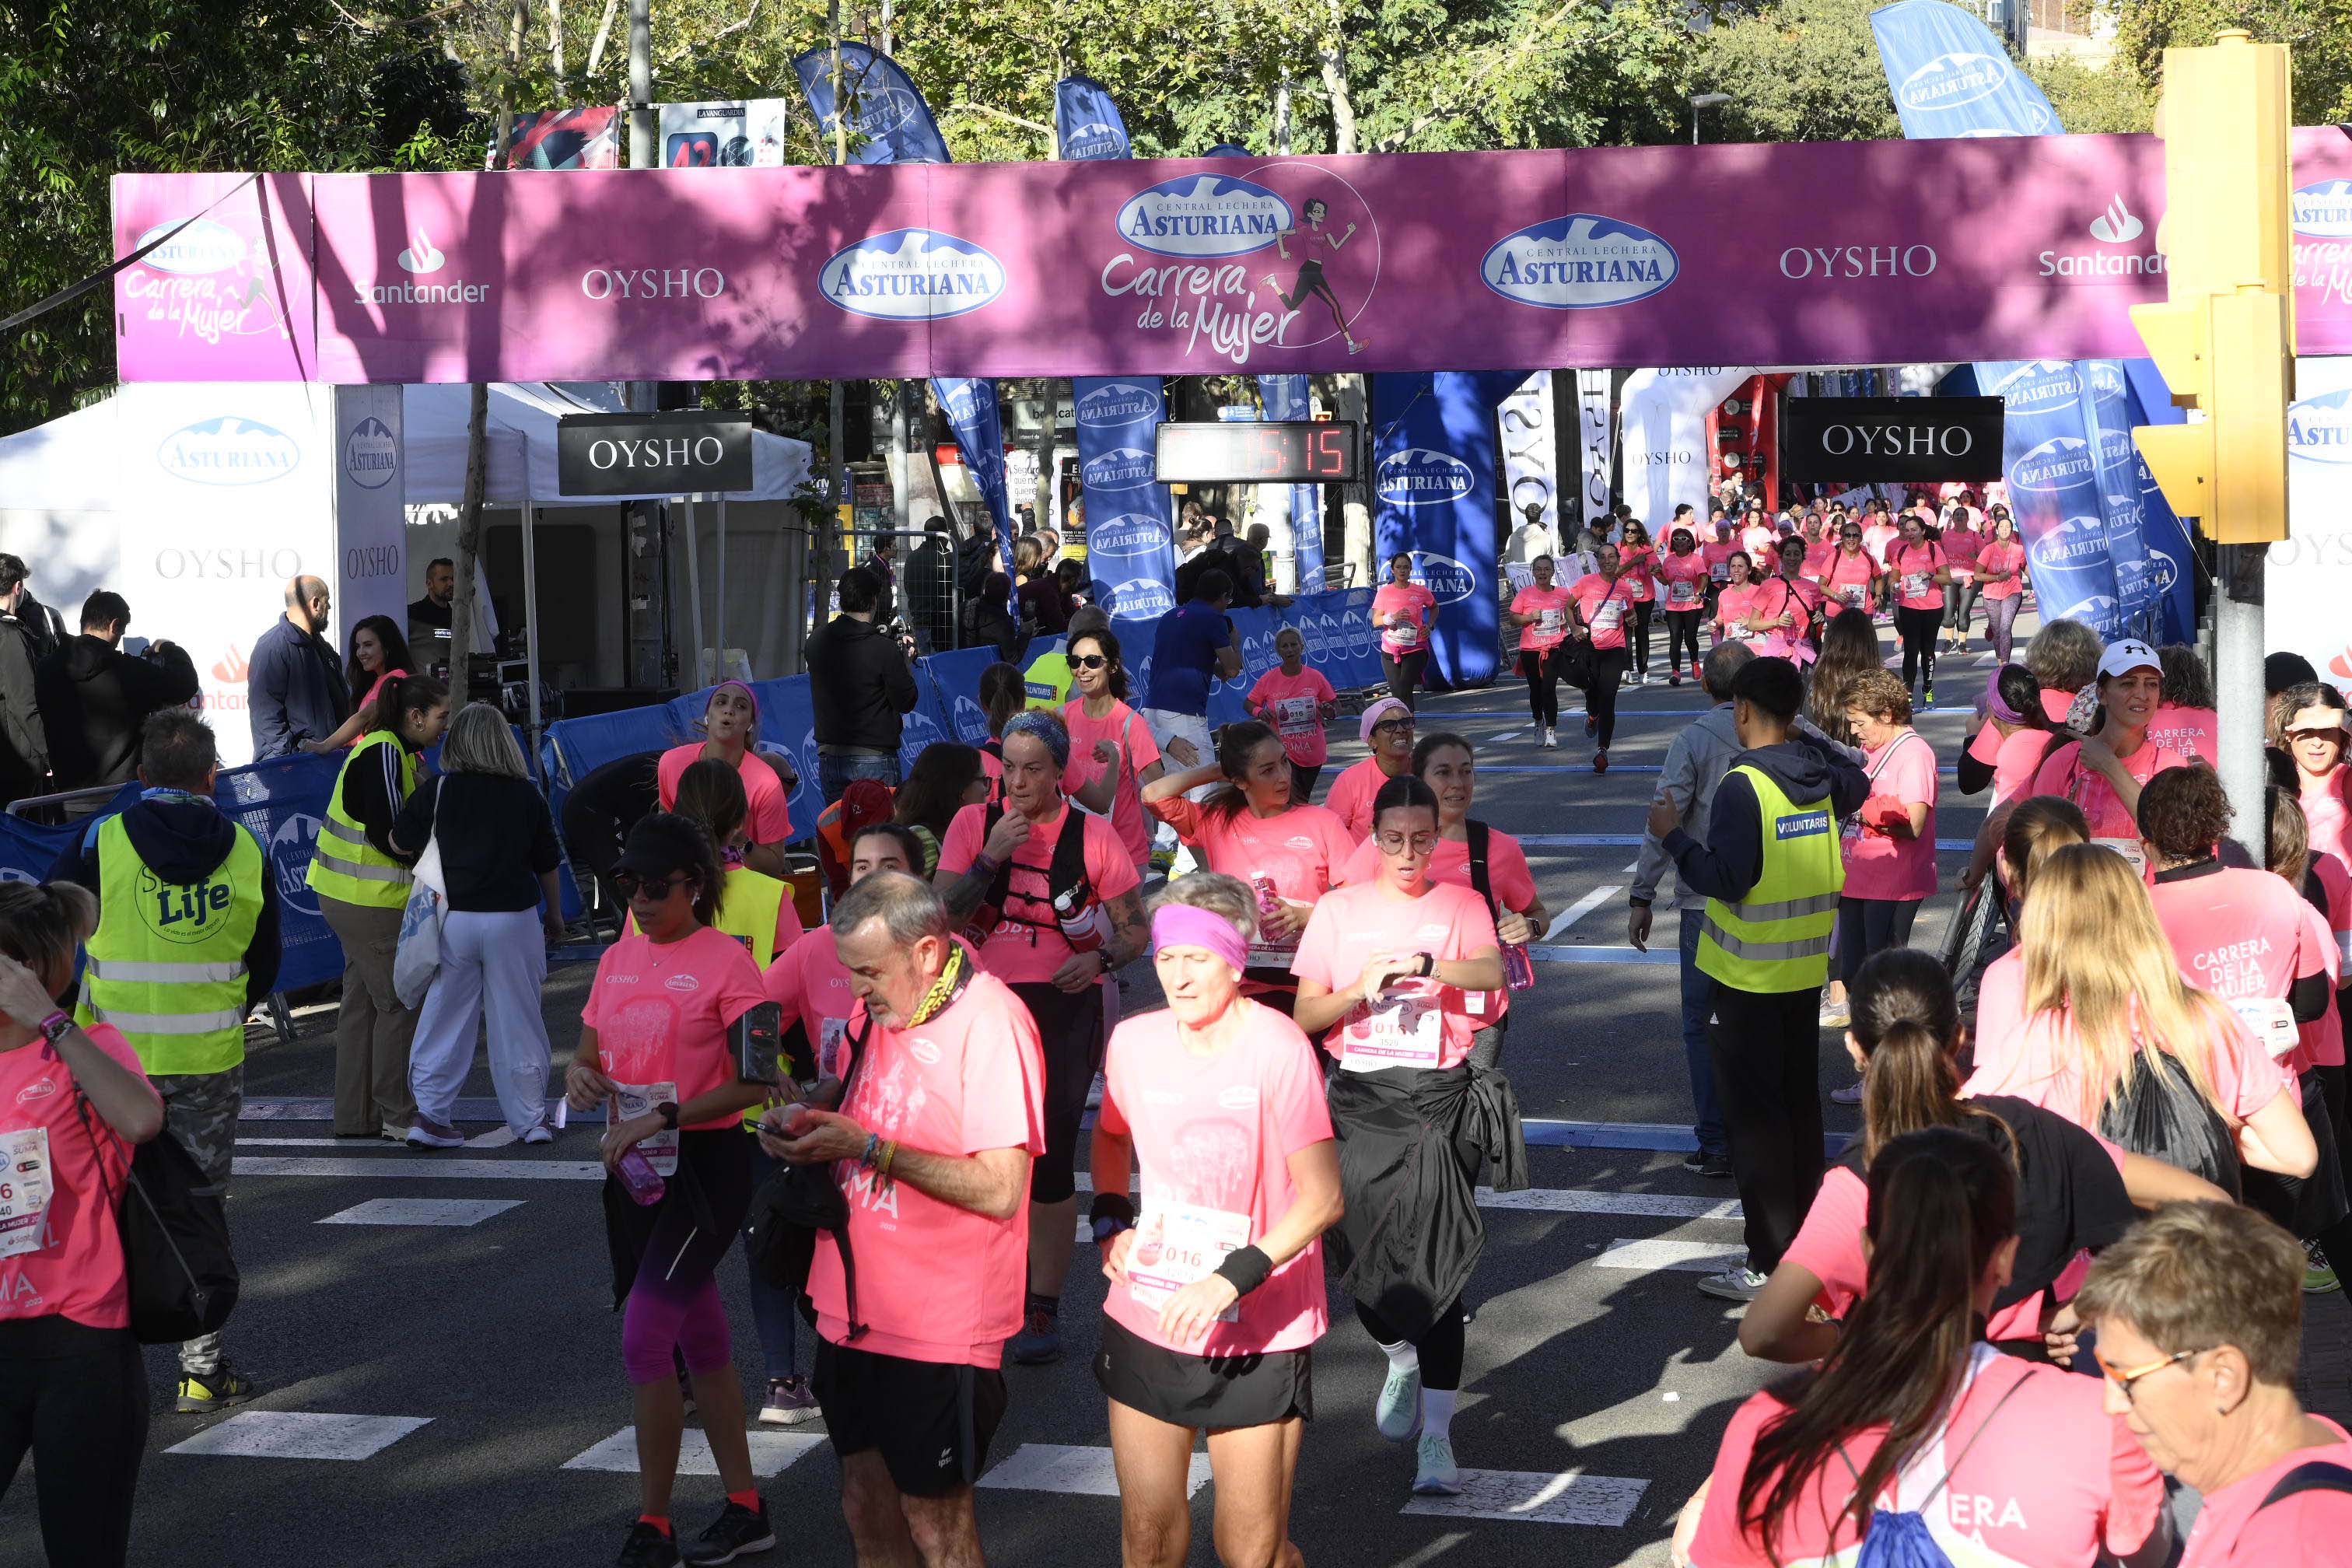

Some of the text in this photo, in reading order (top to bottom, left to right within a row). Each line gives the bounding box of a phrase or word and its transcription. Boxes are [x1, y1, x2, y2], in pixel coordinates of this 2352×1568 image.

[1157, 201, 1274, 212] CENTRAL LECHERA
[1130, 205, 1279, 237] ASTURIANA
[860, 260, 985, 269] CENTRAL LECHERA
[1526, 245, 1657, 258] CENTRAL LECHERA
[1780, 244, 1937, 279] OYSHO
[833, 263, 990, 296] ASTURIANA
[1101, 254, 1248, 297] Carrera
[1496, 250, 1664, 285] ASTURIANA
[124, 270, 217, 299] Carrera
[354, 279, 490, 304] Santander
[582, 268, 724, 300] OYSHO
[177, 297, 252, 345] Mujer
[1137, 292, 1301, 365] de la Mujer
[589, 436, 723, 469] OYSHO
[1822, 425, 1972, 457] OYSHO
[350, 449, 394, 471] ASTURIANA
[1633, 451, 1691, 465] OYSHO
[1379, 471, 1467, 492] ASTURIANA
[156, 548, 303, 579] OYSHO
[348, 544, 398, 579] OYSHO
[1283, 741, 1312, 753] SUMA
[2156, 737, 2194, 747] DE LA
[1777, 817, 1828, 834] VOLUNTARIS
[157, 878, 229, 926] Life
[2193, 936, 2272, 971] CARRERA
[606, 975, 639, 984] OYSHO
[2210, 957, 2262, 984] DE LA
[13, 1145, 38, 1156] SUMA
[0, 1183, 12, 1199] 6
[8, 1217, 29, 1229] MUJER
[1167, 1247, 1202, 1267] 016
